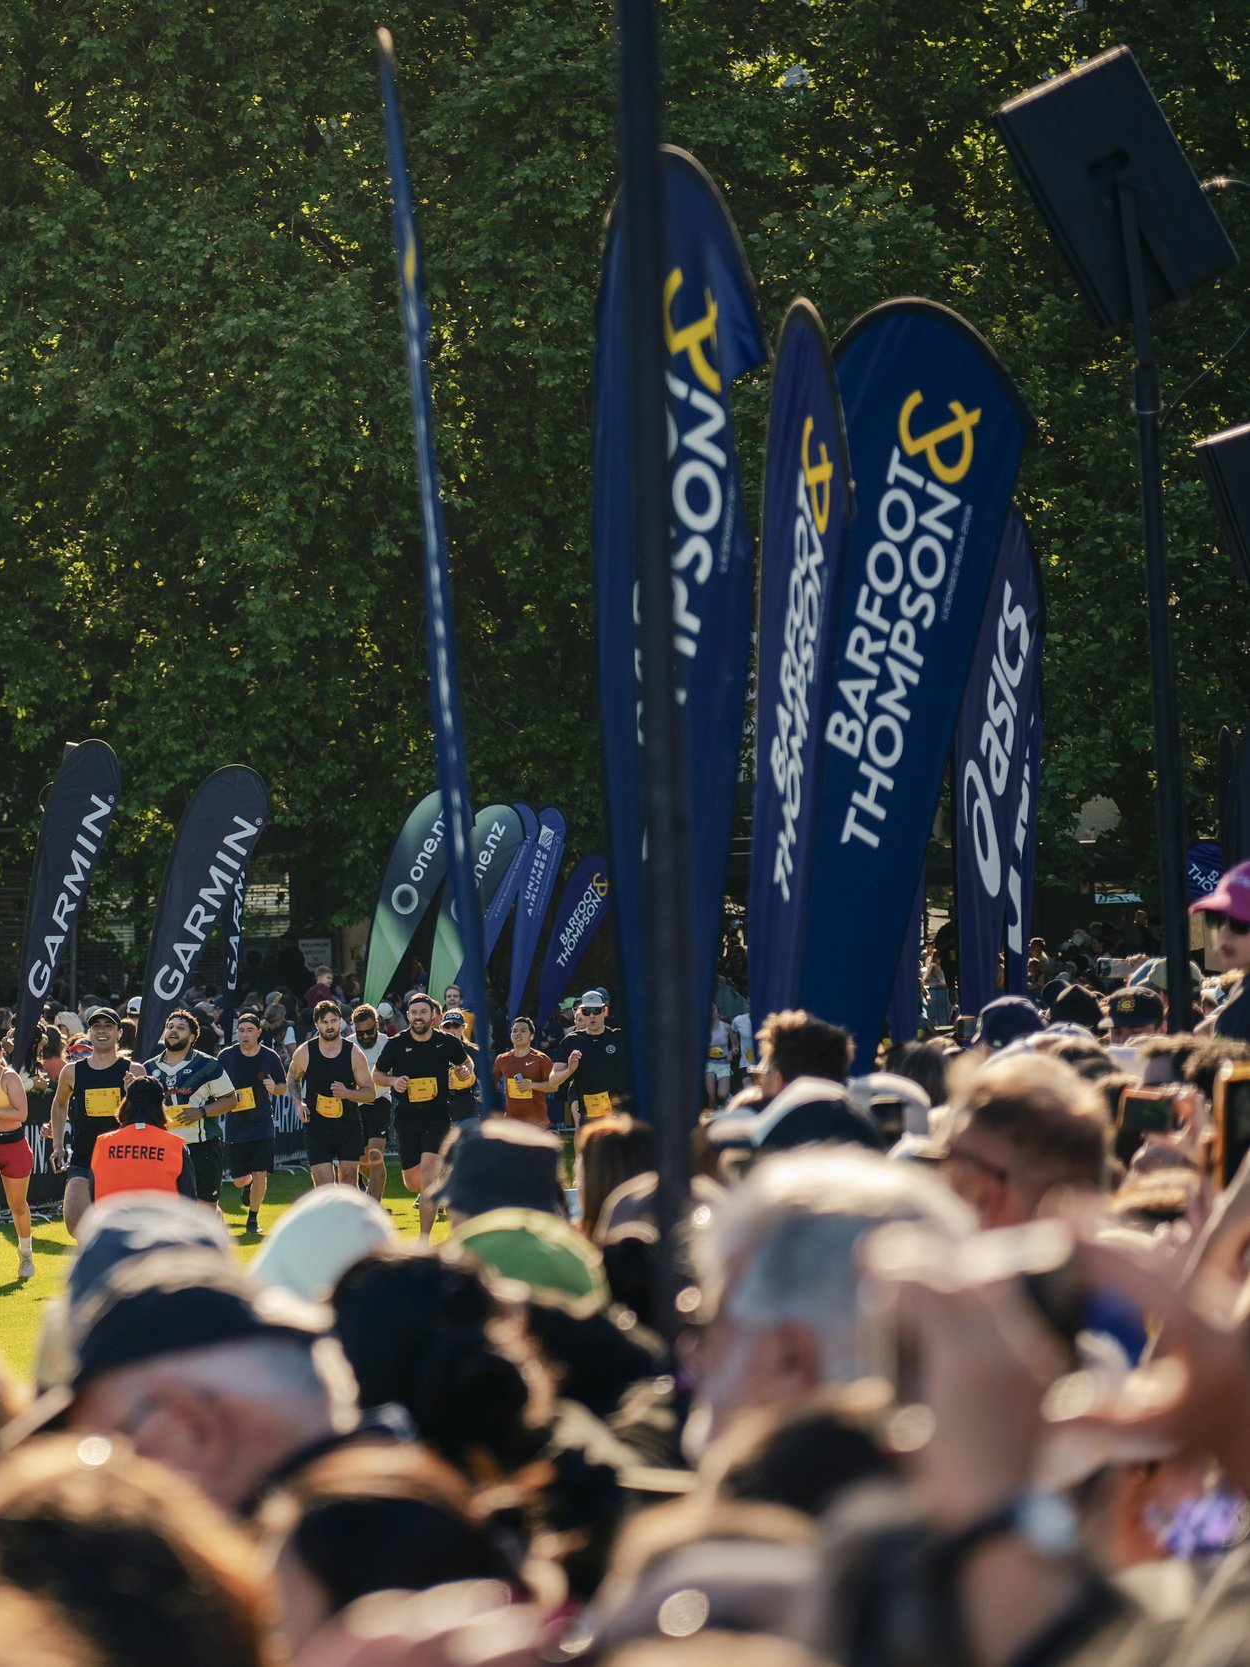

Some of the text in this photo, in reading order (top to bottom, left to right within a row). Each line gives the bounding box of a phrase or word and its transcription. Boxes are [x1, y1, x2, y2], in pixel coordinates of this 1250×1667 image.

[770, 469, 813, 795] BARFOOT
[825, 446, 926, 759] BARFOOT
[840, 480, 962, 849] THOMPSON
[980, 578, 1030, 797] asics
[773, 521, 826, 903] THOMPSON
[410, 809, 447, 882] one.n
[524, 849, 542, 900] UNITED
[528, 852, 549, 917] AIRLINES
[559, 882, 596, 945] BARFOOT
[556, 893, 603, 967] THOMPSON
[108, 1144, 166, 1162] REFEREE
